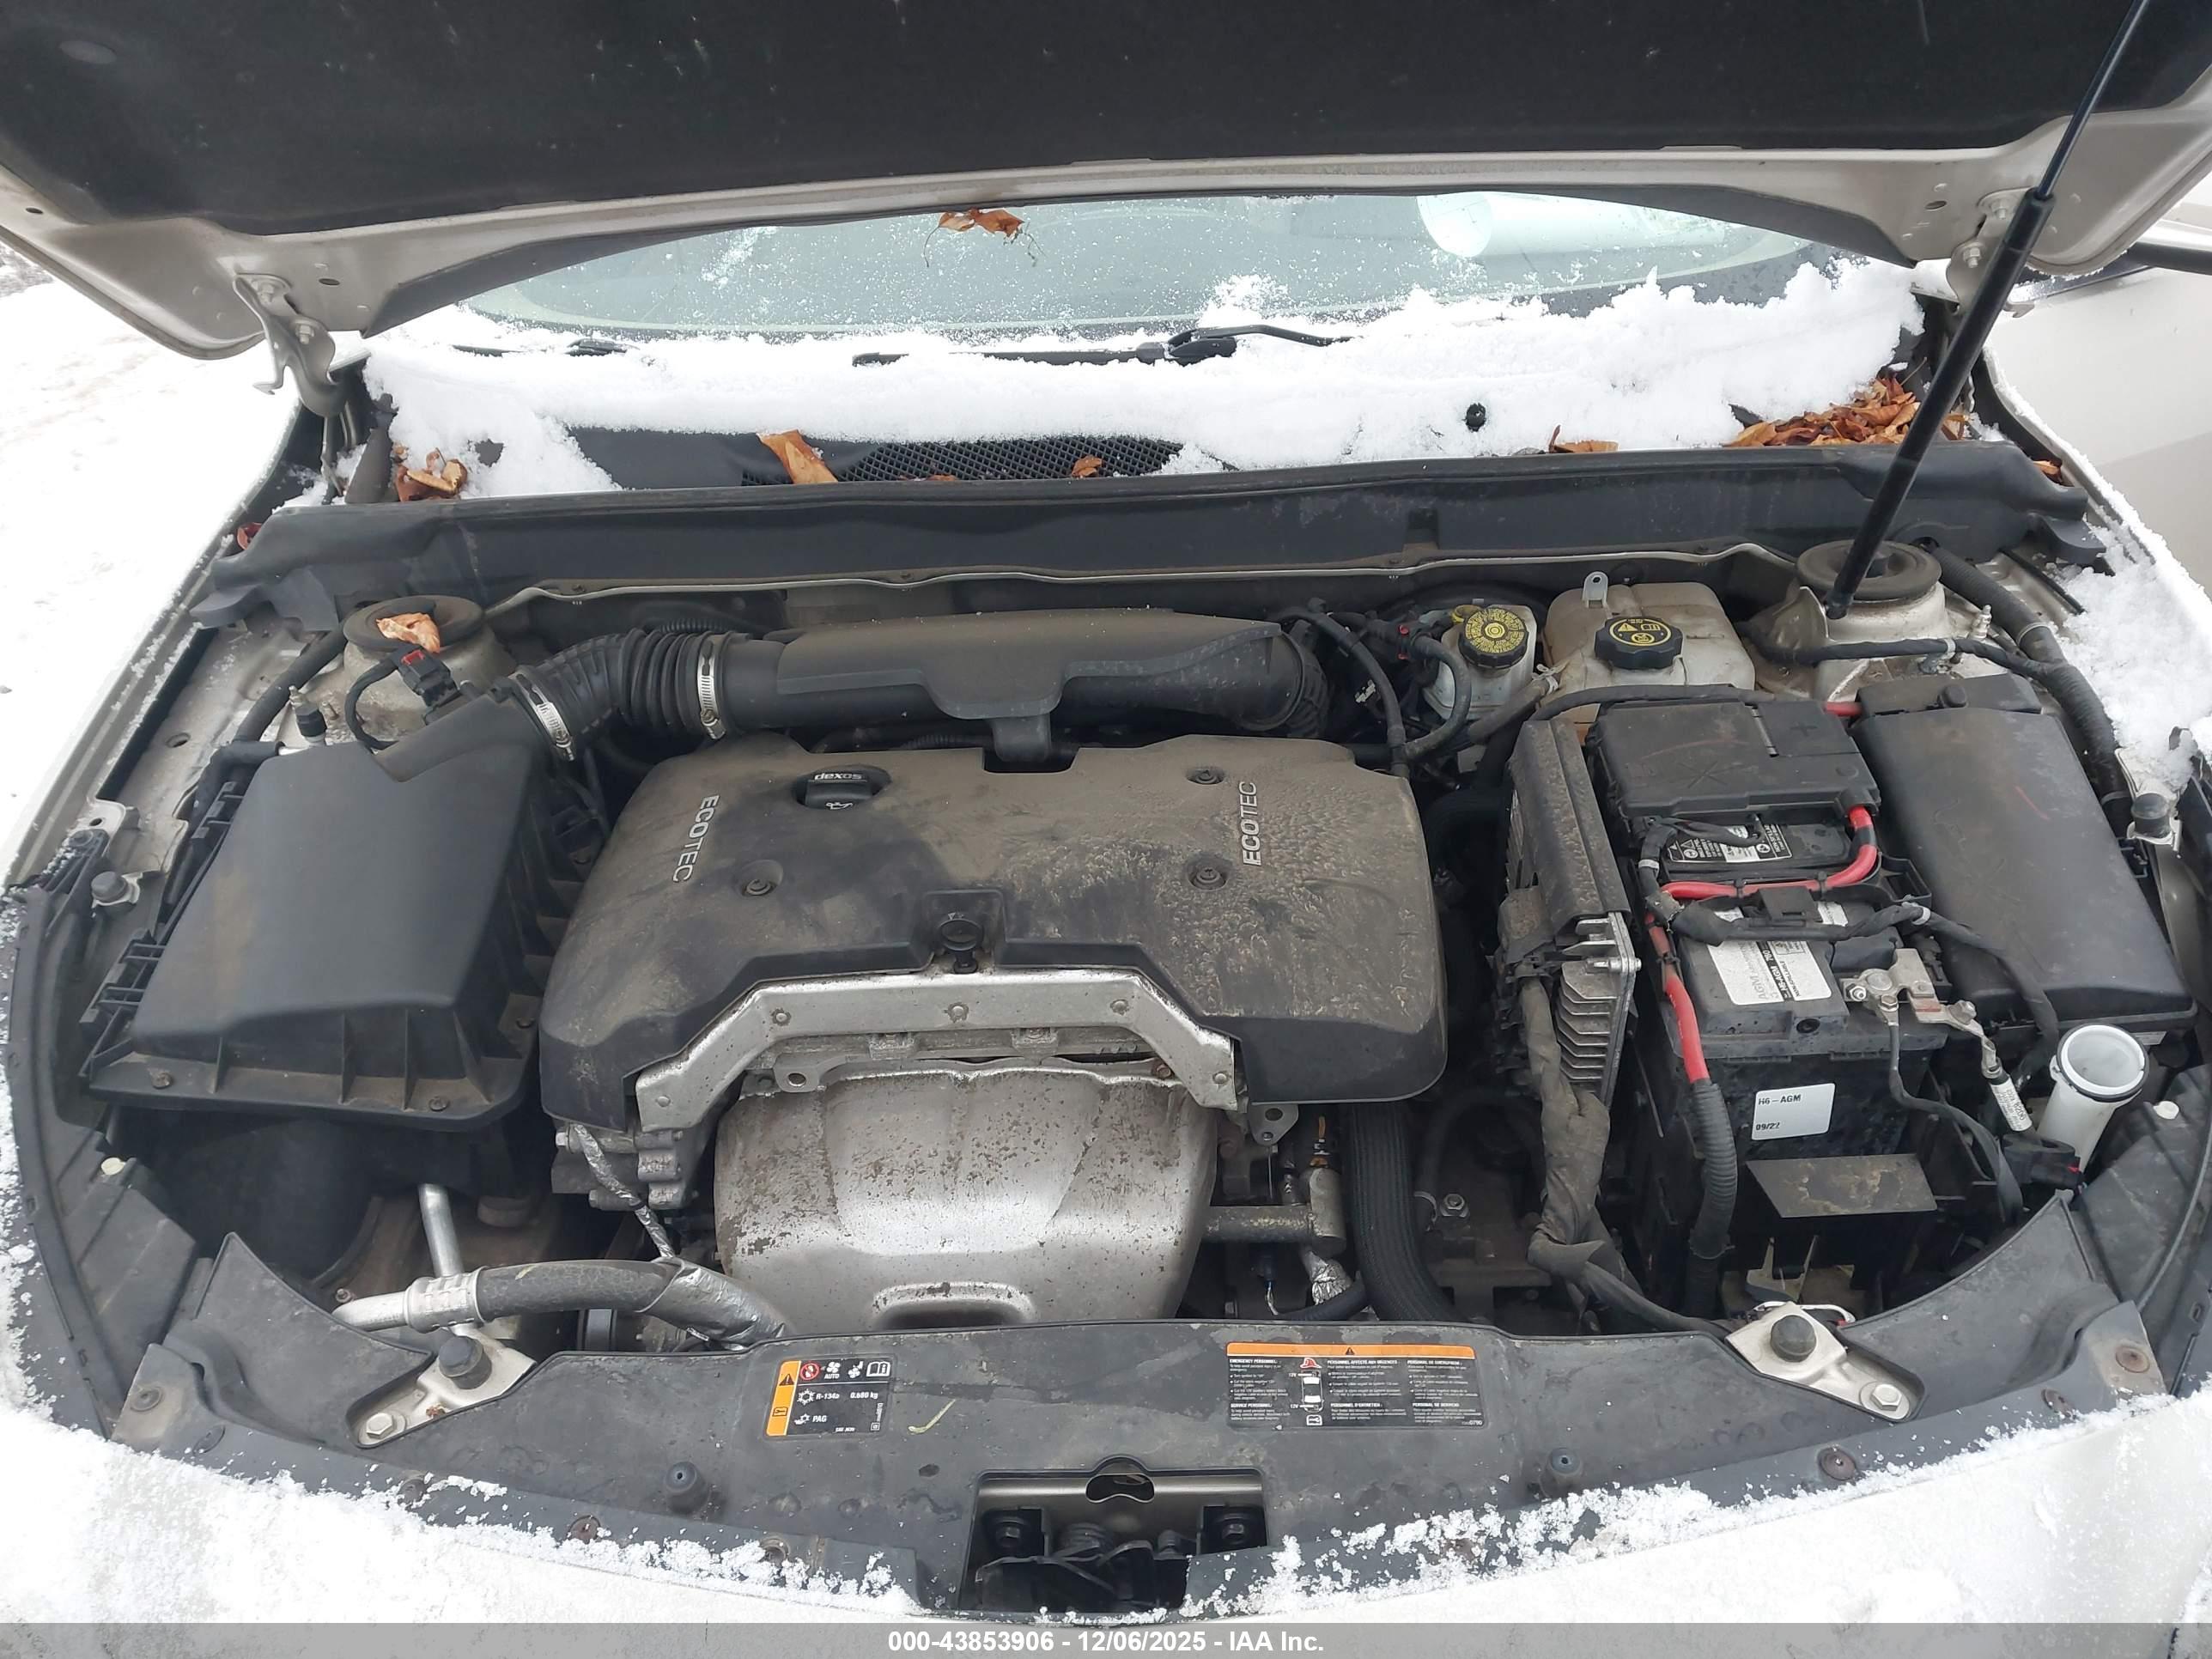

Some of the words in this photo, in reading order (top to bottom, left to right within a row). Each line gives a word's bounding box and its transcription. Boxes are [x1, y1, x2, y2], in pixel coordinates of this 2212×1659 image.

[814, 772, 862, 781] dexos
[672, 794, 720, 882] ECOTEC
[1238, 781, 1262, 866] ECOTEC
